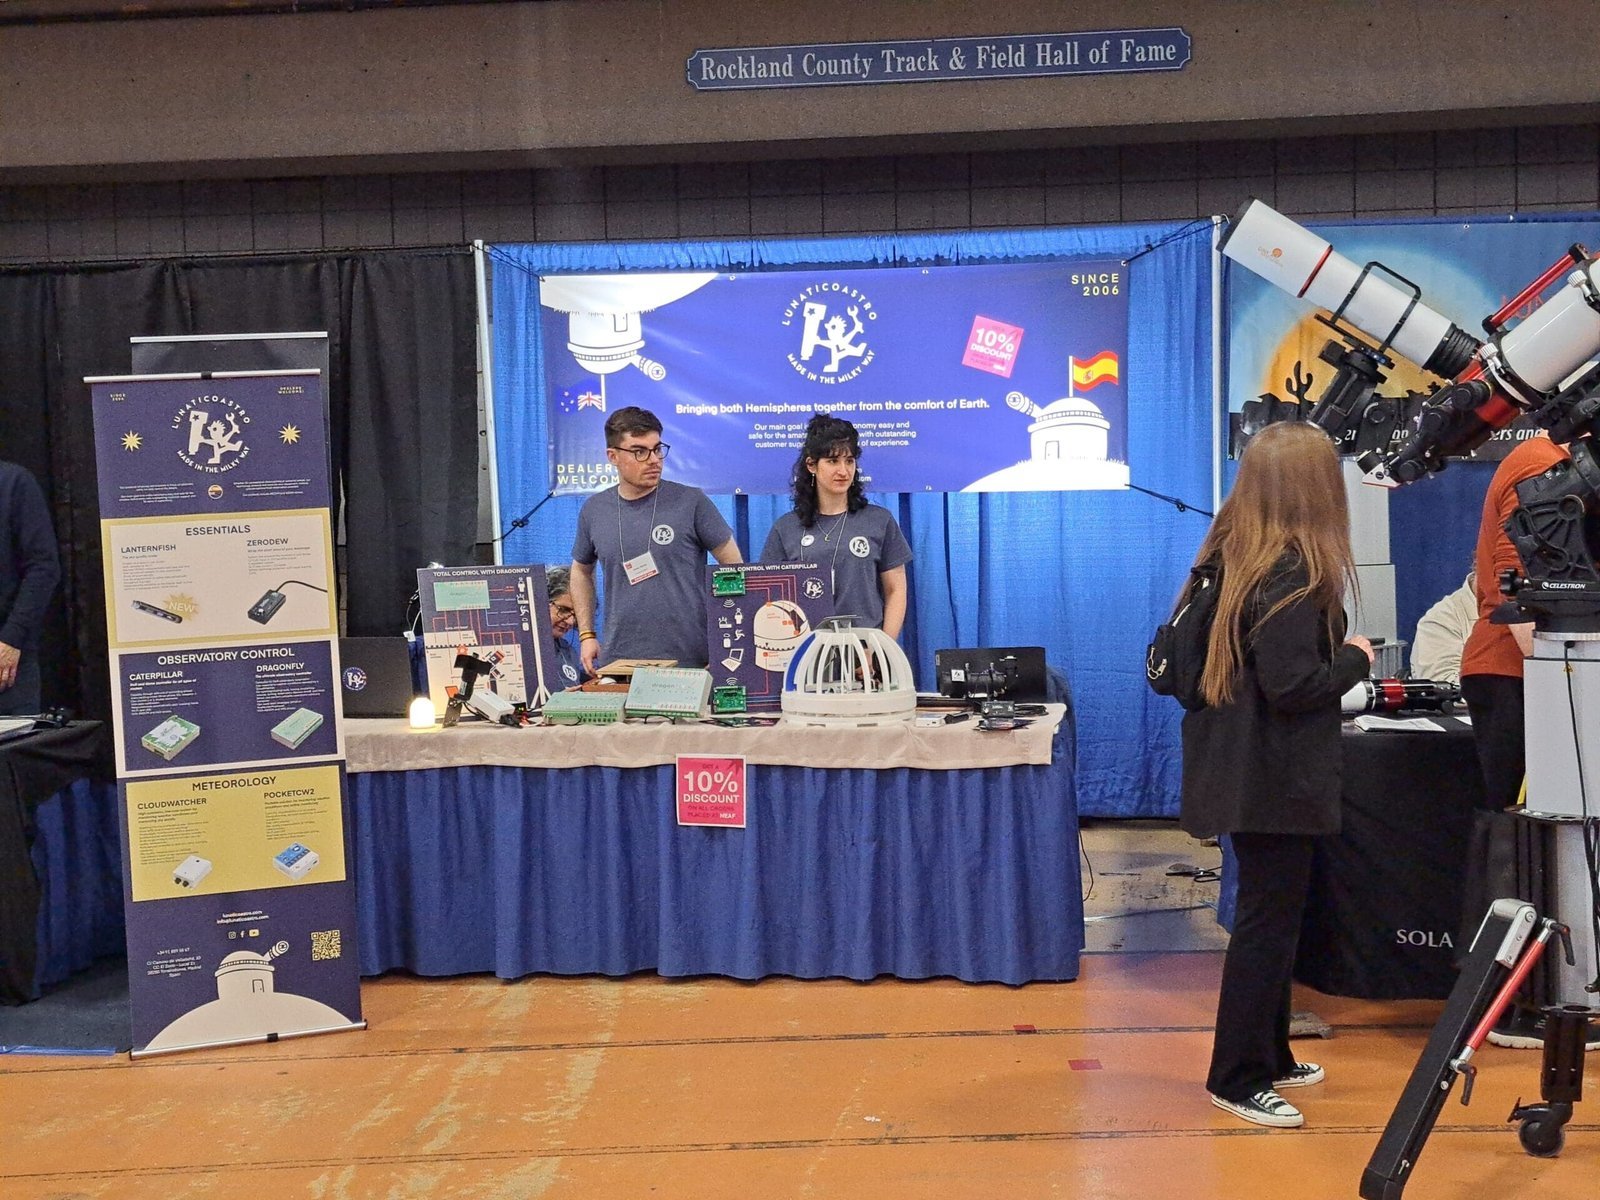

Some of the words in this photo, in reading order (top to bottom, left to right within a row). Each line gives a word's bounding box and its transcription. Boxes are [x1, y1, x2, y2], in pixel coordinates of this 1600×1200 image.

[701, 53, 793, 81] Rockland
[803, 52, 873, 78] County
[881, 48, 939, 72] Track
[949, 46, 967, 70] &
[976, 44, 1025, 69] Field
[1036, 41, 1079, 67] Hall
[1088, 40, 1110, 64] of
[1120, 39, 1176, 63] Fame
[1071, 273, 1119, 285] SINCE
[1083, 285, 1119, 296] 2006
[782, 283, 877, 326] LUNATICOASTRO
[976, 328, 1015, 352] 10%
[970, 343, 1013, 361] DISCOUNT
[787, 353, 807, 375] MADE
[807, 371, 817, 381] IN
[819, 376, 835, 384] THE
[838, 366, 862, 383] MILKY
[861, 350, 875, 366] WAY
[171, 395, 250, 429] LUNATICOASTRO
[676, 403, 718, 415] Bringing
[720, 403, 743, 413] both
[745, 402, 812, 414] Hemispheres
[814, 401, 857, 414] together
[859, 401, 883, 411] from
[885, 400, 902, 410] the
[904, 400, 945, 410] comfort
[947, 399, 958, 409] of
[960, 398, 990, 409] Earth.
[787, 423, 803, 432] goal
[748, 432, 763, 440] safe
[875, 430, 917, 438] outstanding
[177, 450, 194, 466] MADE
[220, 458, 240, 472] MILKY
[239, 446, 250, 458] WAY
[185, 524, 251, 536] ESSENTIALS
[247, 538, 288, 546] ZERODEW
[121, 544, 176, 553] LANTERNFISH
[168, 601, 195, 613] NEW
[157, 651, 238, 665] OBSERVATORY
[241, 648, 295, 661] CONTROL
[256, 662, 305, 672] DRAGONFLY
[129, 671, 183, 681] CATERPILLAR
[192, 776, 277, 792] METEOROLOGY
[683, 771, 738, 793] 10%
[263, 788, 315, 799] POCKETCW2
[683, 793, 740, 803] DISCOUNT
[137, 797, 207, 810] CLOUDWATCHER
